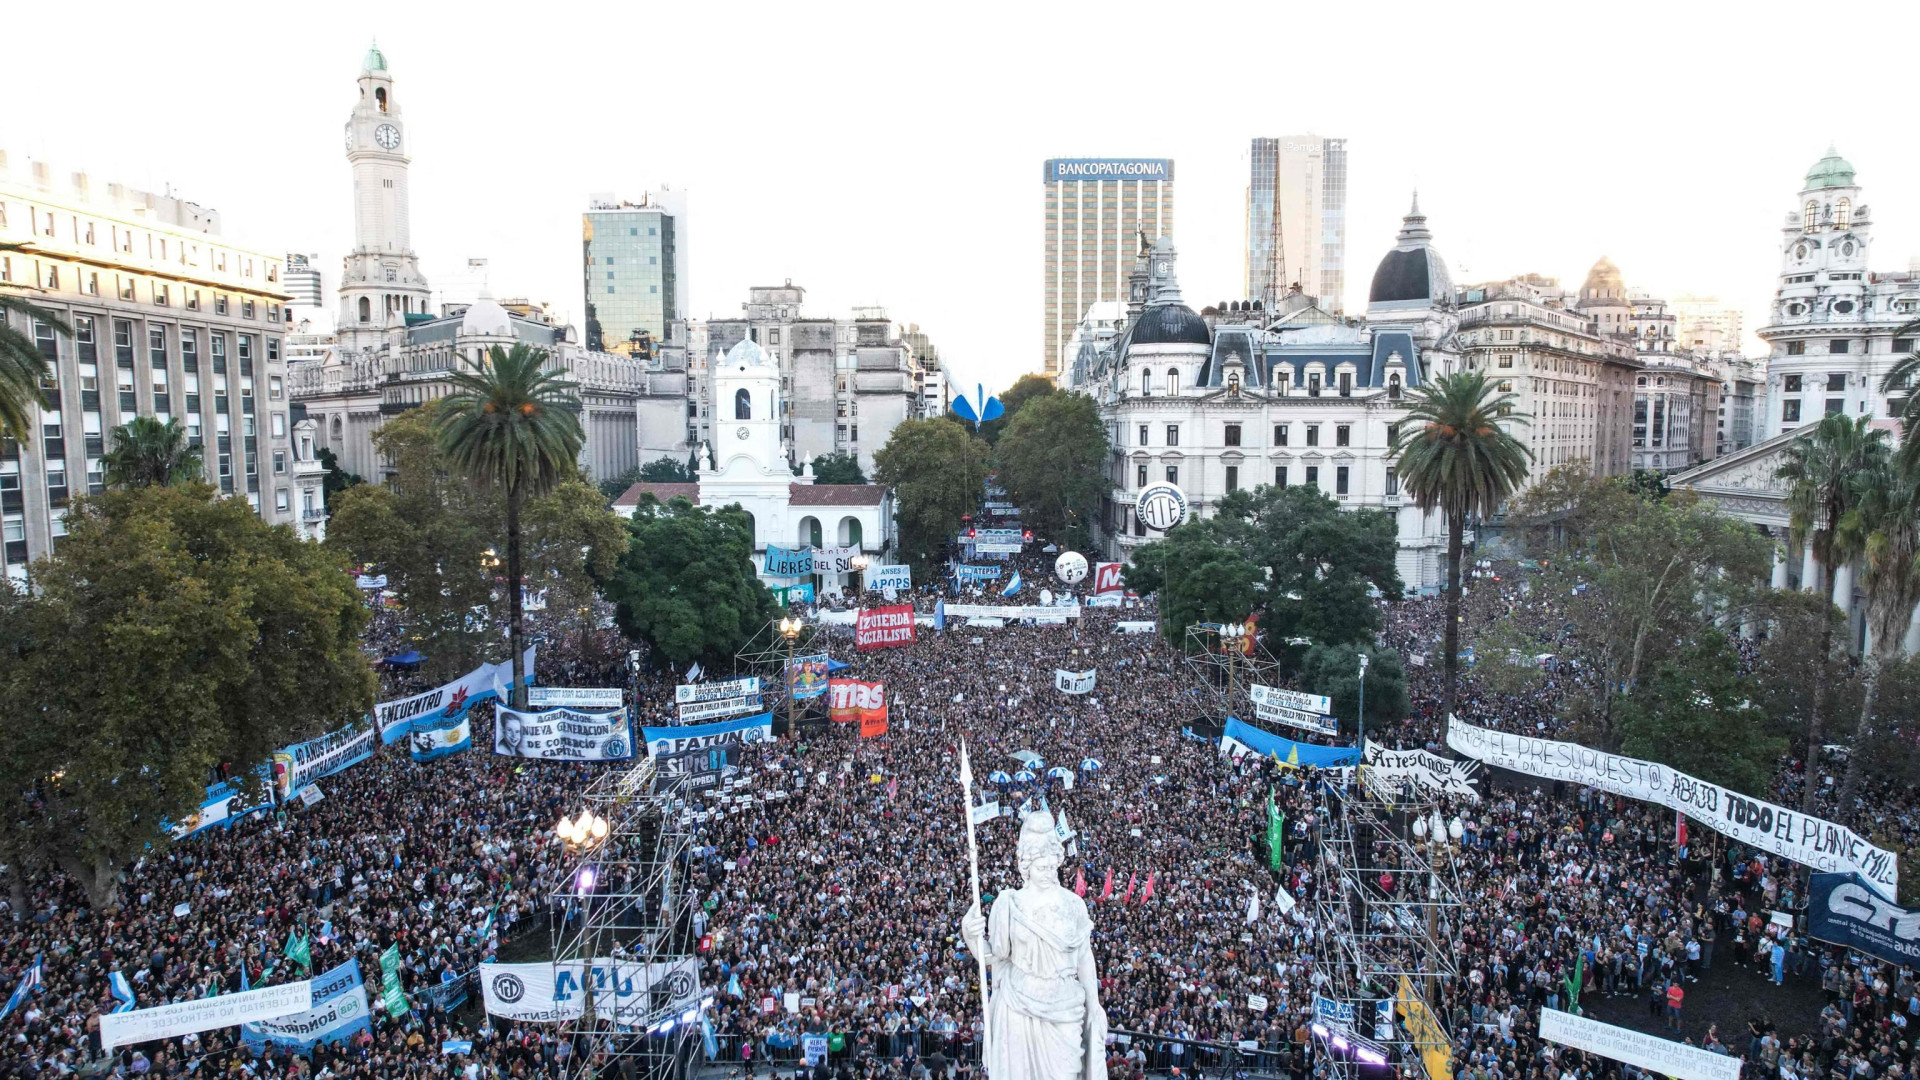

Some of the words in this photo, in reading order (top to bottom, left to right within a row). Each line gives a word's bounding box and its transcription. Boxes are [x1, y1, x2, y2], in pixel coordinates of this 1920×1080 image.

[1058, 162, 1164, 175] BANCOPATAGONIA
[1145, 496, 1178, 525] ATE
[768, 556, 812, 574] LIBRES
[814, 560, 831, 571] DEL
[858, 628, 912, 645] SOCIALISTA
[832, 683, 883, 709] mas
[382, 690, 443, 727] ENCUENTRO
[521, 725, 552, 735] NUEVA
[557, 722, 609, 735] GENERACION
[527, 740, 540, 748] DE
[546, 737, 596, 749] COMERCIO
[675, 730, 743, 752] FATUN
[541, 747, 585, 758] CAPITAL
[1368, 746, 1453, 775] Artesanos
[1491, 733, 1509, 756] EL
[1671, 773, 1718, 812] ABAJO
[1724, 792, 1773, 833] TODO
[1774, 810, 1794, 843] EL
[1801, 818, 1846, 857] PLAN
[1491, 755, 1504, 765] NO
[1552, 769, 1562, 778] LA
[1568, 771, 1584, 783] LEY
[1647, 789, 1653, 800] Y
[1683, 802, 1739, 837] PROTOCOLO
[1751, 832, 1764, 846] DE
[1828, 918, 1848, 926] central
[1865, 933, 1893, 949] argentina
